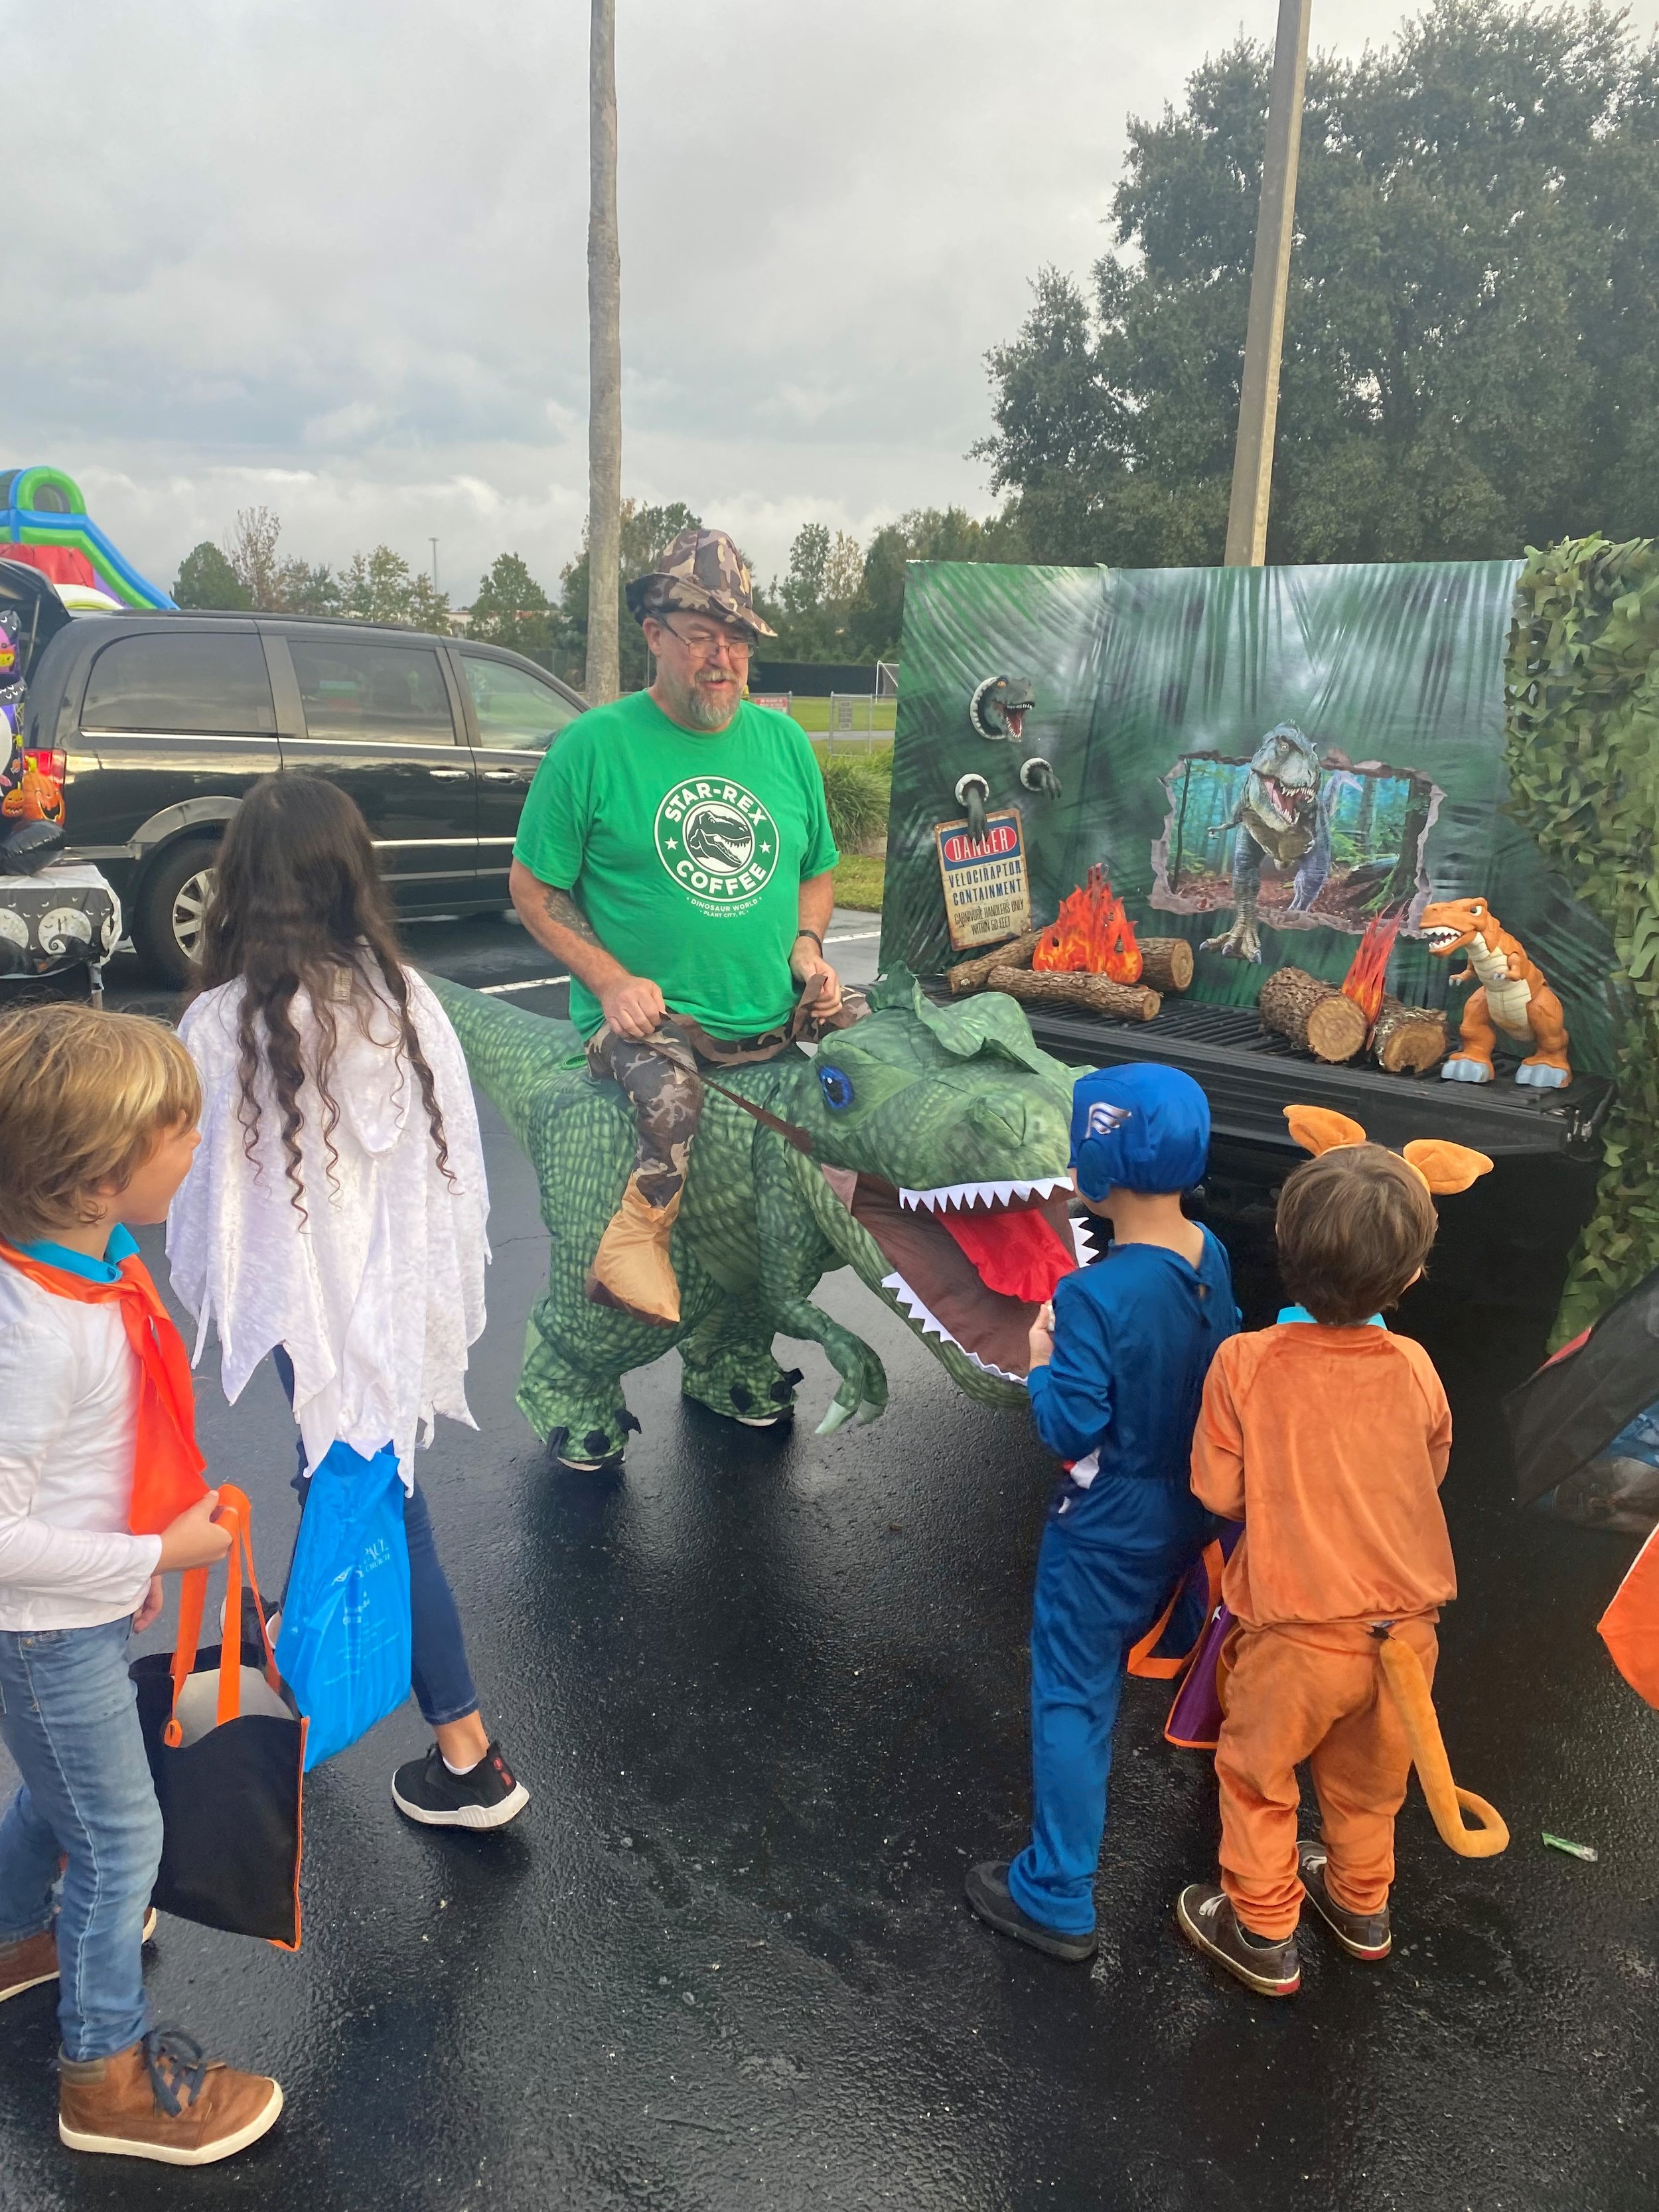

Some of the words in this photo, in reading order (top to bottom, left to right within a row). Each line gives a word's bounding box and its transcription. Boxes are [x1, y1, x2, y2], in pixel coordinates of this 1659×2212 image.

[664, 782, 767, 826] STAR-REX
[952, 828, 1009, 861] DANGER
[676, 860, 767, 895] COFFEE
[948, 860, 1021, 888] VELOCIRAPTOR
[690, 899, 731, 912] DINOSAUR
[732, 899, 758, 911] WORLD
[953, 879, 1021, 905] CONTAINMENT
[954, 907, 983, 925] CARNIVORE
[984, 901, 1011, 918] HANDLERS
[1011, 899, 1024, 912] ONLY
[971, 920, 991, 935] WITHIN
[991, 918, 999, 930] 50
[999, 916, 1011, 928] FEET
